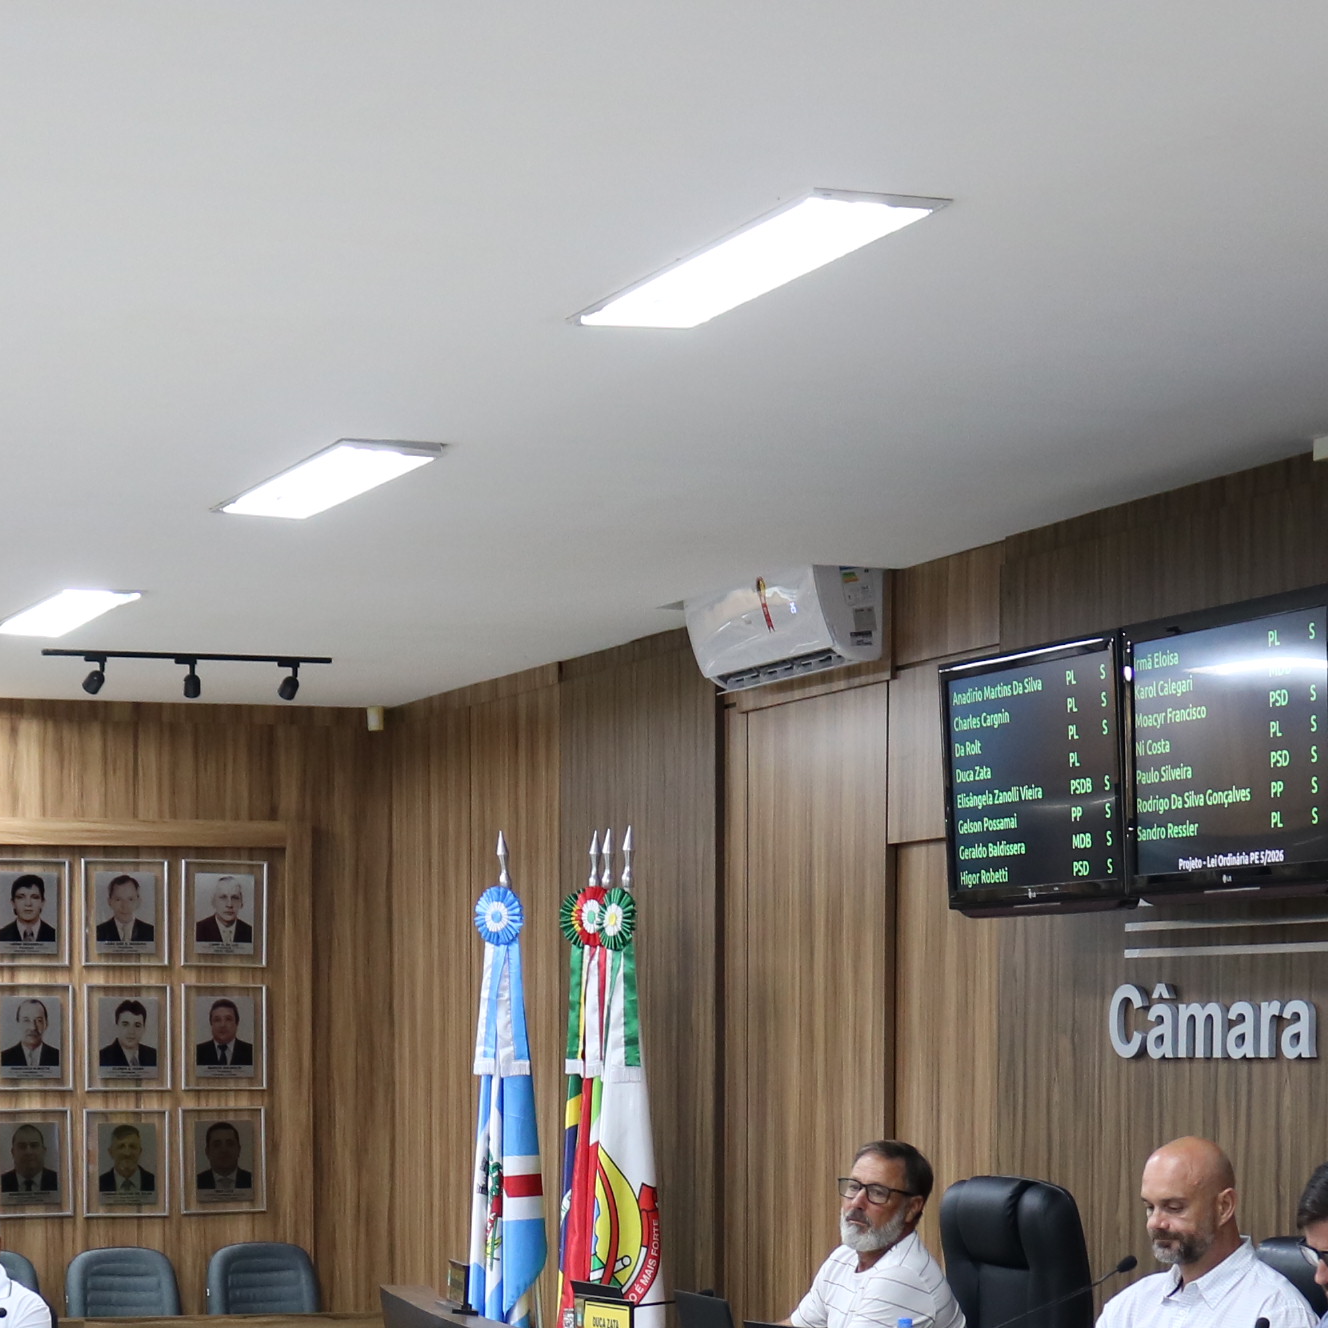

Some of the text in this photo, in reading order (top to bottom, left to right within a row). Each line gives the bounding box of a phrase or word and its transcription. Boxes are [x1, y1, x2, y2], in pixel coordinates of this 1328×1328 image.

[1154, 650, 1179, 668] Eloisa
[1268, 630, 1280, 647] PL
[1309, 622, 1315, 640] S
[984, 682, 1012, 700] Martins
[1013, 681, 1023, 695] Da
[1024, 677, 1042, 693] Silva
[1066, 669, 1077, 686] PL
[1100, 664, 1106, 680] S
[1135, 682, 1157, 701] Karol
[1158, 675, 1193, 697] Calegari
[954, 691, 1107, 732] Charles Cargnin PL S
[1135, 684, 1317, 729] Moacyr Francisco PSD S
[955, 719, 1108, 758] Da Rolt PL S
[1136, 715, 1317, 757] Ni Costa PL S
[956, 751, 1080, 784] Duca Zata PL
[1137, 746, 1317, 784] Paulo Silveira PSD S
[994, 785, 1020, 804] Zanolli
[1020, 784, 1043, 801] Vieira
[1070, 777, 1092, 795] PSDB
[1104, 775, 1110, 791] S
[1137, 776, 1318, 814] Rodrigo Da Silva Gonçalves PP S
[958, 803, 1111, 834] Gelson Possamai PP S
[1137, 807, 1318, 841] Sandro Ressler PL S
[959, 830, 1112, 860] Geraldo Baldissera MDB S
[1178, 857, 1203, 872] Projeto
[1207, 854, 1217, 868] Lei
[1218, 852, 1249, 867] Ordinária
[1249, 852, 1260, 864] PE
[1260, 850, 1284, 866] 5/2026
[960, 858, 1113, 888] Higor Robetti PSD S
[1109, 983, 1317, 1060] Câmara
[639, 1258, 657, 1286] MAIS
[650, 1219, 660, 1257] FORTE
[593, 1315, 606, 1328] DUCA
